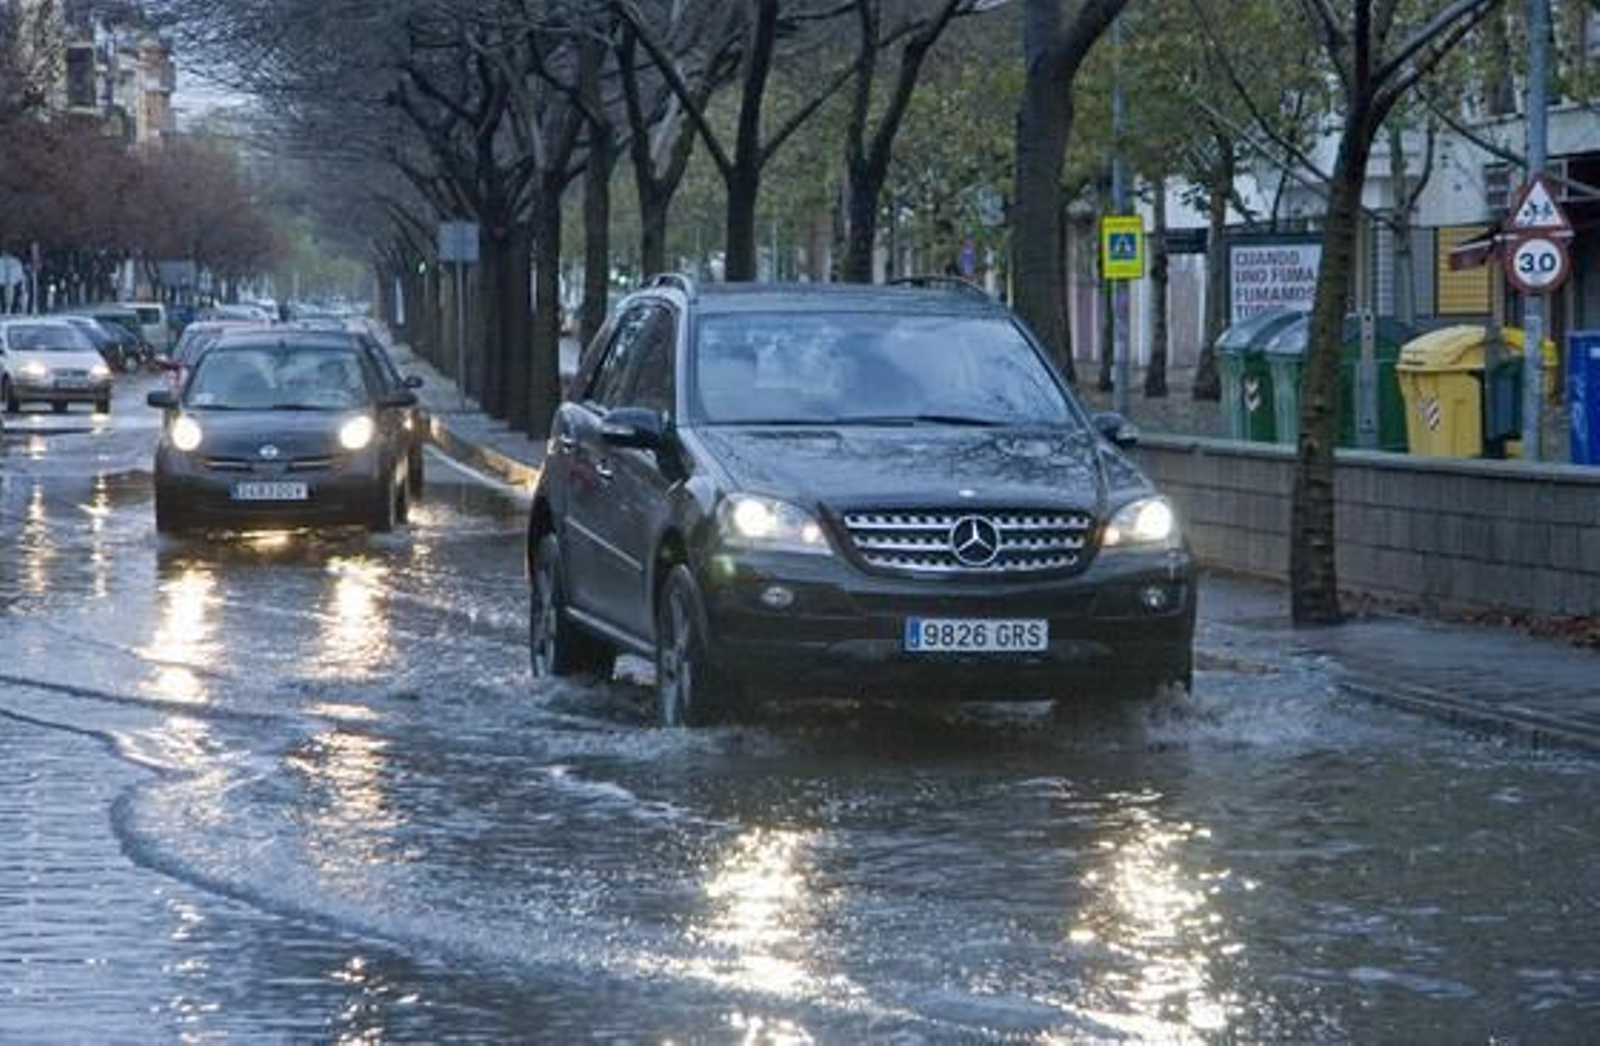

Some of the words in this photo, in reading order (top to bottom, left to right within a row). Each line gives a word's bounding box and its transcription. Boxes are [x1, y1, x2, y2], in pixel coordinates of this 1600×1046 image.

[1235, 250, 1300, 266] CUANDO
[1519, 252, 1557, 273] 30
[1235, 269, 1268, 284] UNO
[1271, 267, 1315, 283] FUMA
[923, 623, 987, 647] 9826
[995, 623, 1041, 647] GRS
